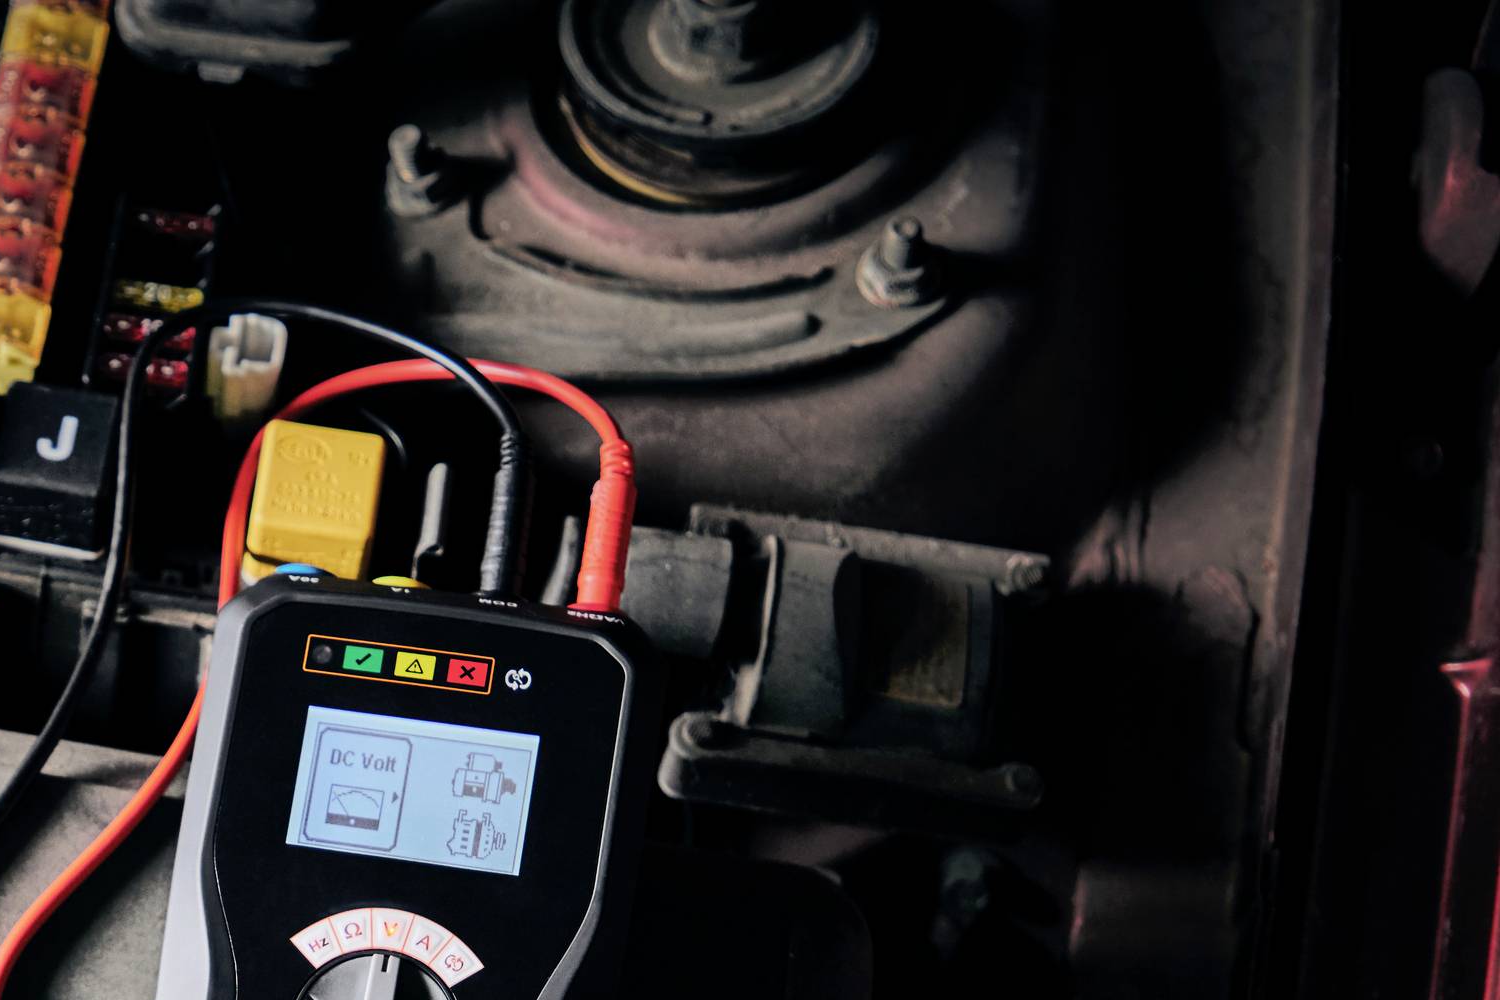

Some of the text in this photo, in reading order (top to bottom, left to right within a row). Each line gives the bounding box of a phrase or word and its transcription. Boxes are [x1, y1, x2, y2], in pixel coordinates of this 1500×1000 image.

[36, 415, 80, 462] J
[330, 748, 397, 773] DC Volt
[308, 936, 330, 953] Hz
[383, 921, 399, 938] V
[415, 935, 431, 951] A
